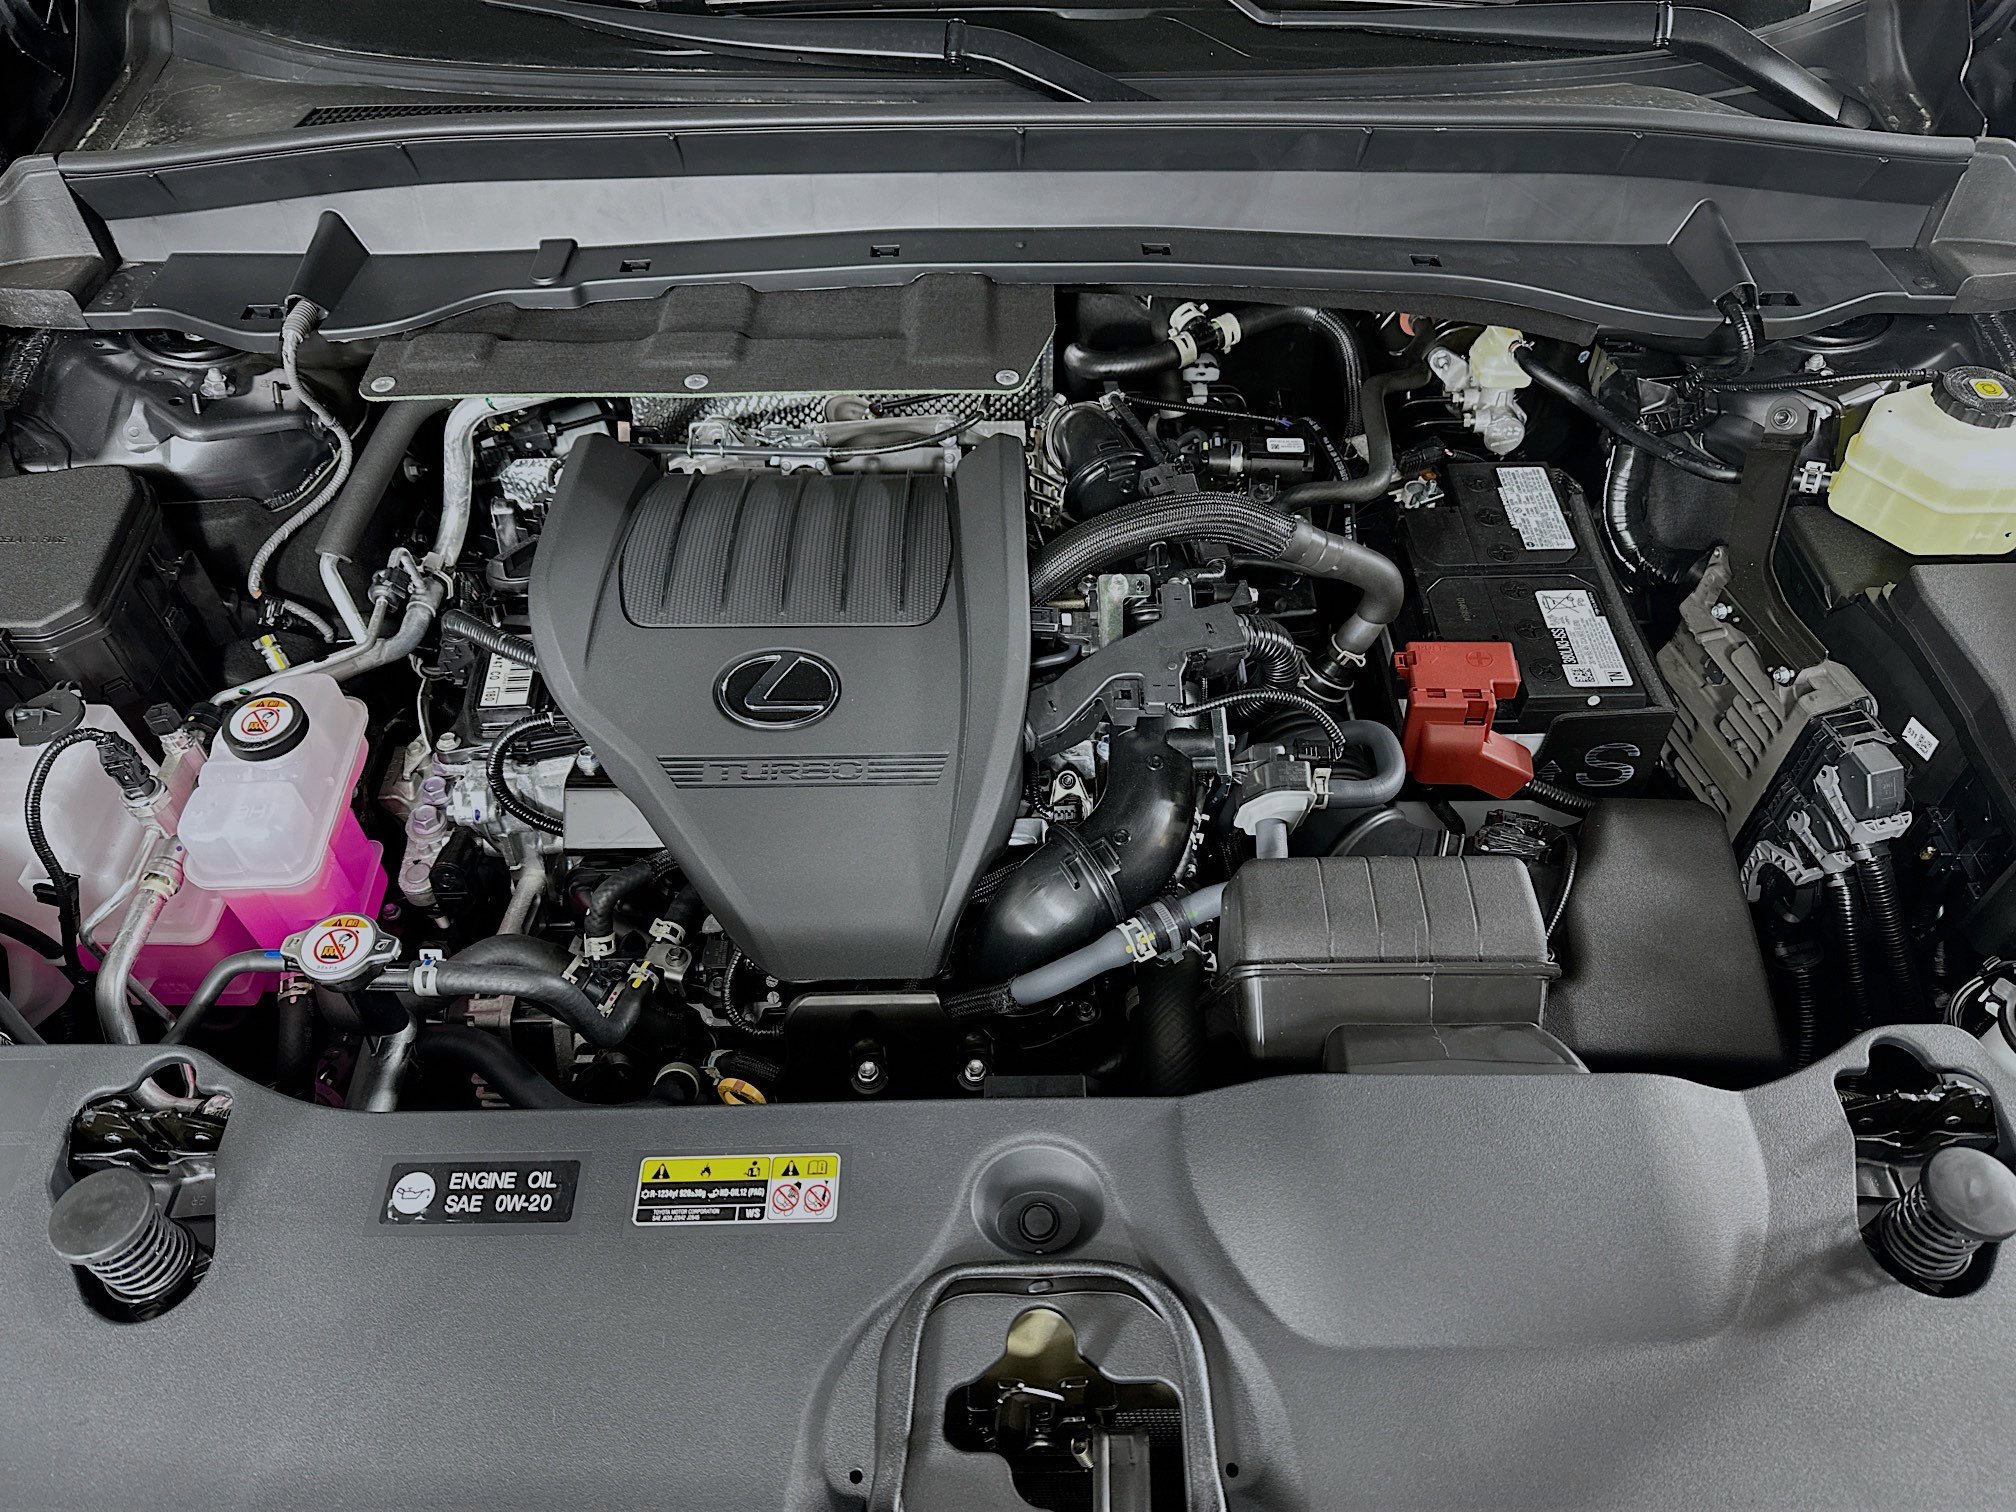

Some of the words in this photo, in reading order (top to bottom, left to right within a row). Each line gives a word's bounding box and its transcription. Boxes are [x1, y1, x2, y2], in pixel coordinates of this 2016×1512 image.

[1607, 671, 1625, 682] TN
[708, 761, 863, 782] TURBO
[449, 1171, 518, 1190] ENGINE
[527, 1171, 557, 1189] OIL
[444, 1194, 484, 1213] SAE
[494, 1193, 553, 1212] 0W-20
[745, 1208, 761, 1219] WS
